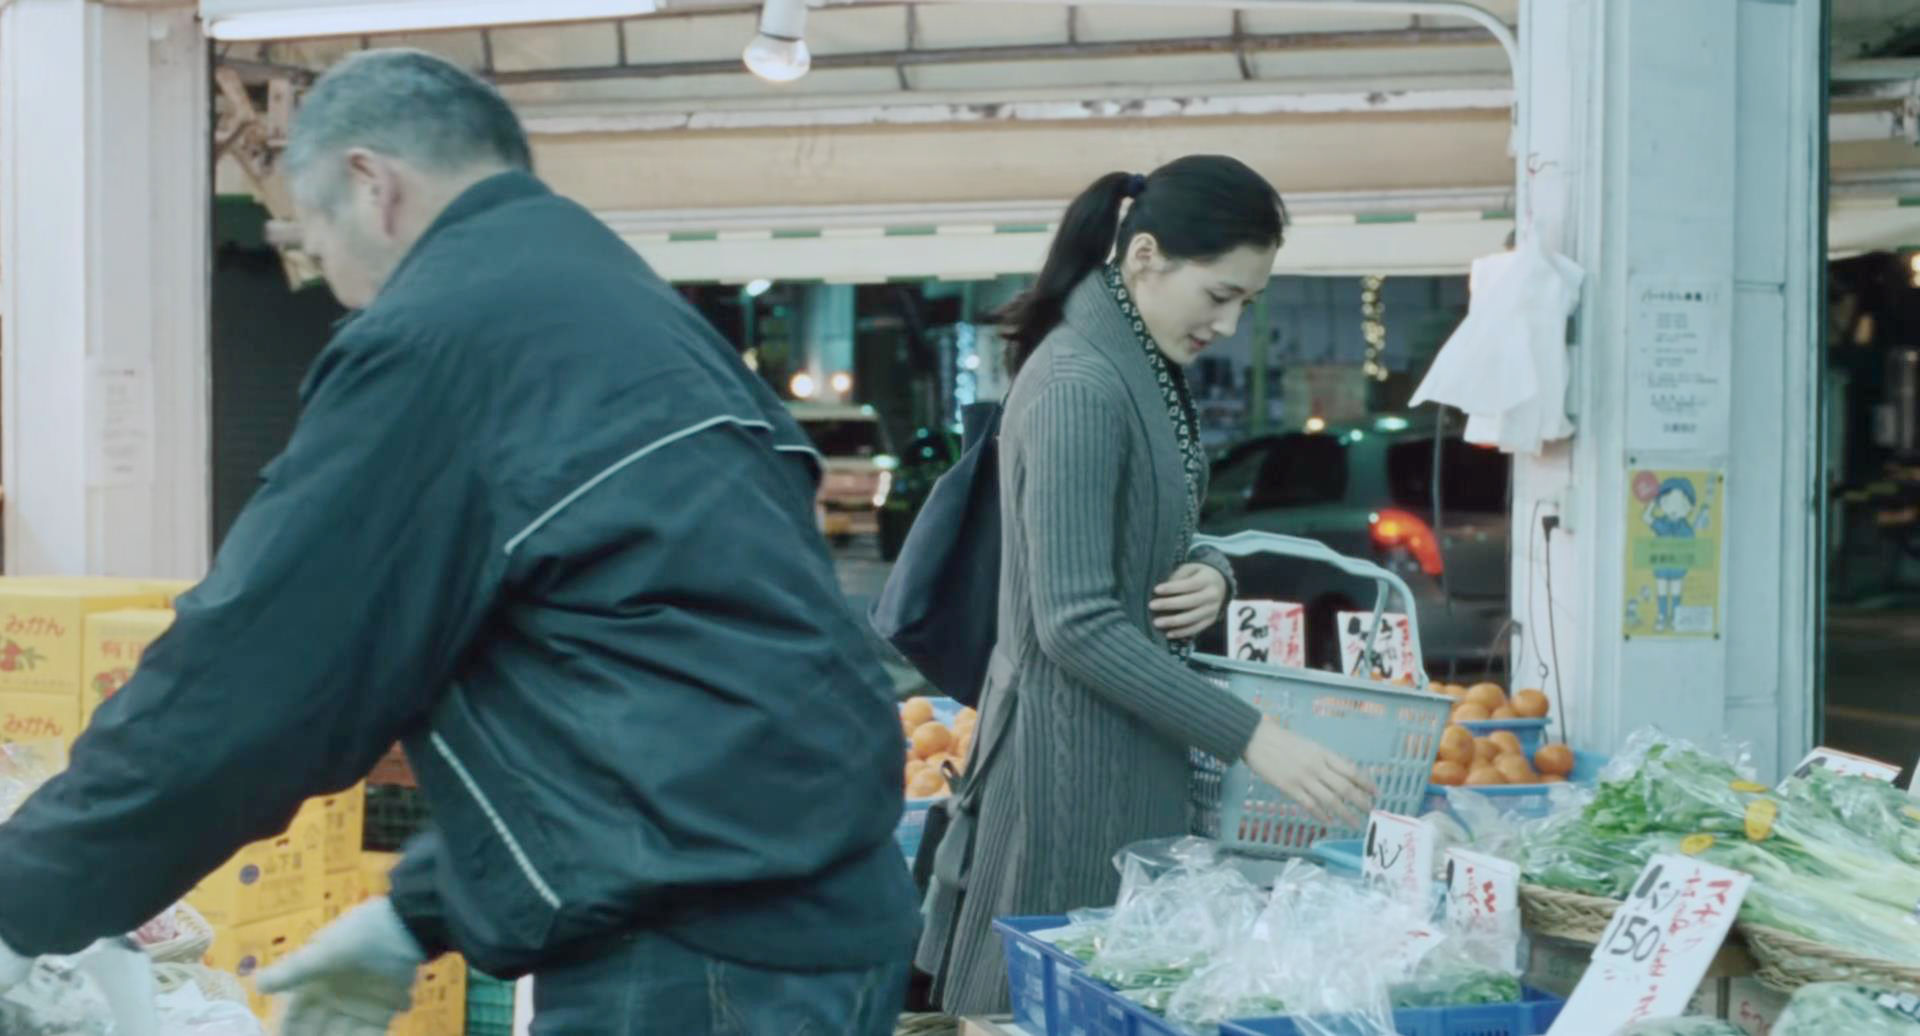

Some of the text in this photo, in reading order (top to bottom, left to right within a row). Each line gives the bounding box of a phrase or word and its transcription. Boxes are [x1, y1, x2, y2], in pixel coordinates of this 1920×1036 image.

[5, 615, 65, 637] みかん
[4, 714, 63, 737] みかん
[1602, 912, 1661, 962] 150
